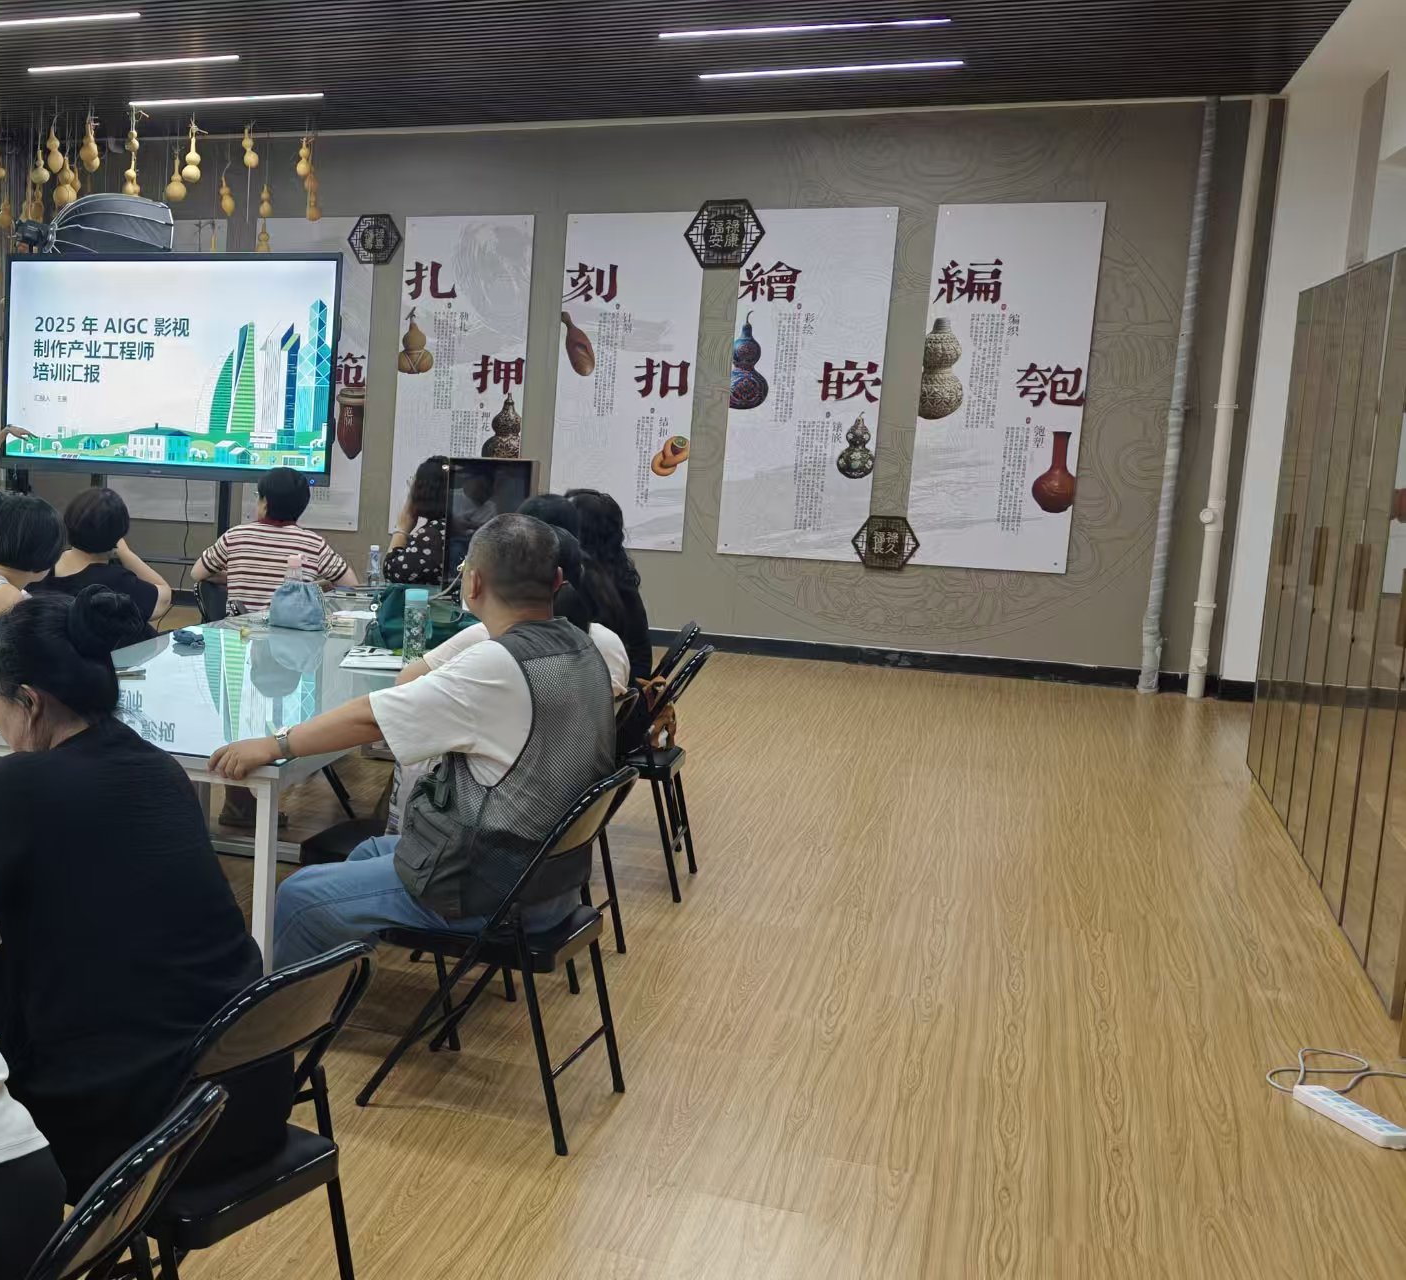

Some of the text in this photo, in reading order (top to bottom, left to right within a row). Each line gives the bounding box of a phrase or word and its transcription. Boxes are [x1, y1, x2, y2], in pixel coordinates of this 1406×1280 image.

[405, 261, 457, 300] 扎
[562, 262, 619, 303] 刻
[738, 260, 802, 303] 繪
[34, 316, 191, 338] 2025 年 AIGC 影视
[33, 339, 155, 361] 制作产业工程师
[32, 362, 101, 383] 培训汇报
[472, 355, 525, 394] 押
[634, 357, 691, 399] 扣
[817, 359, 882, 403] 嵌
